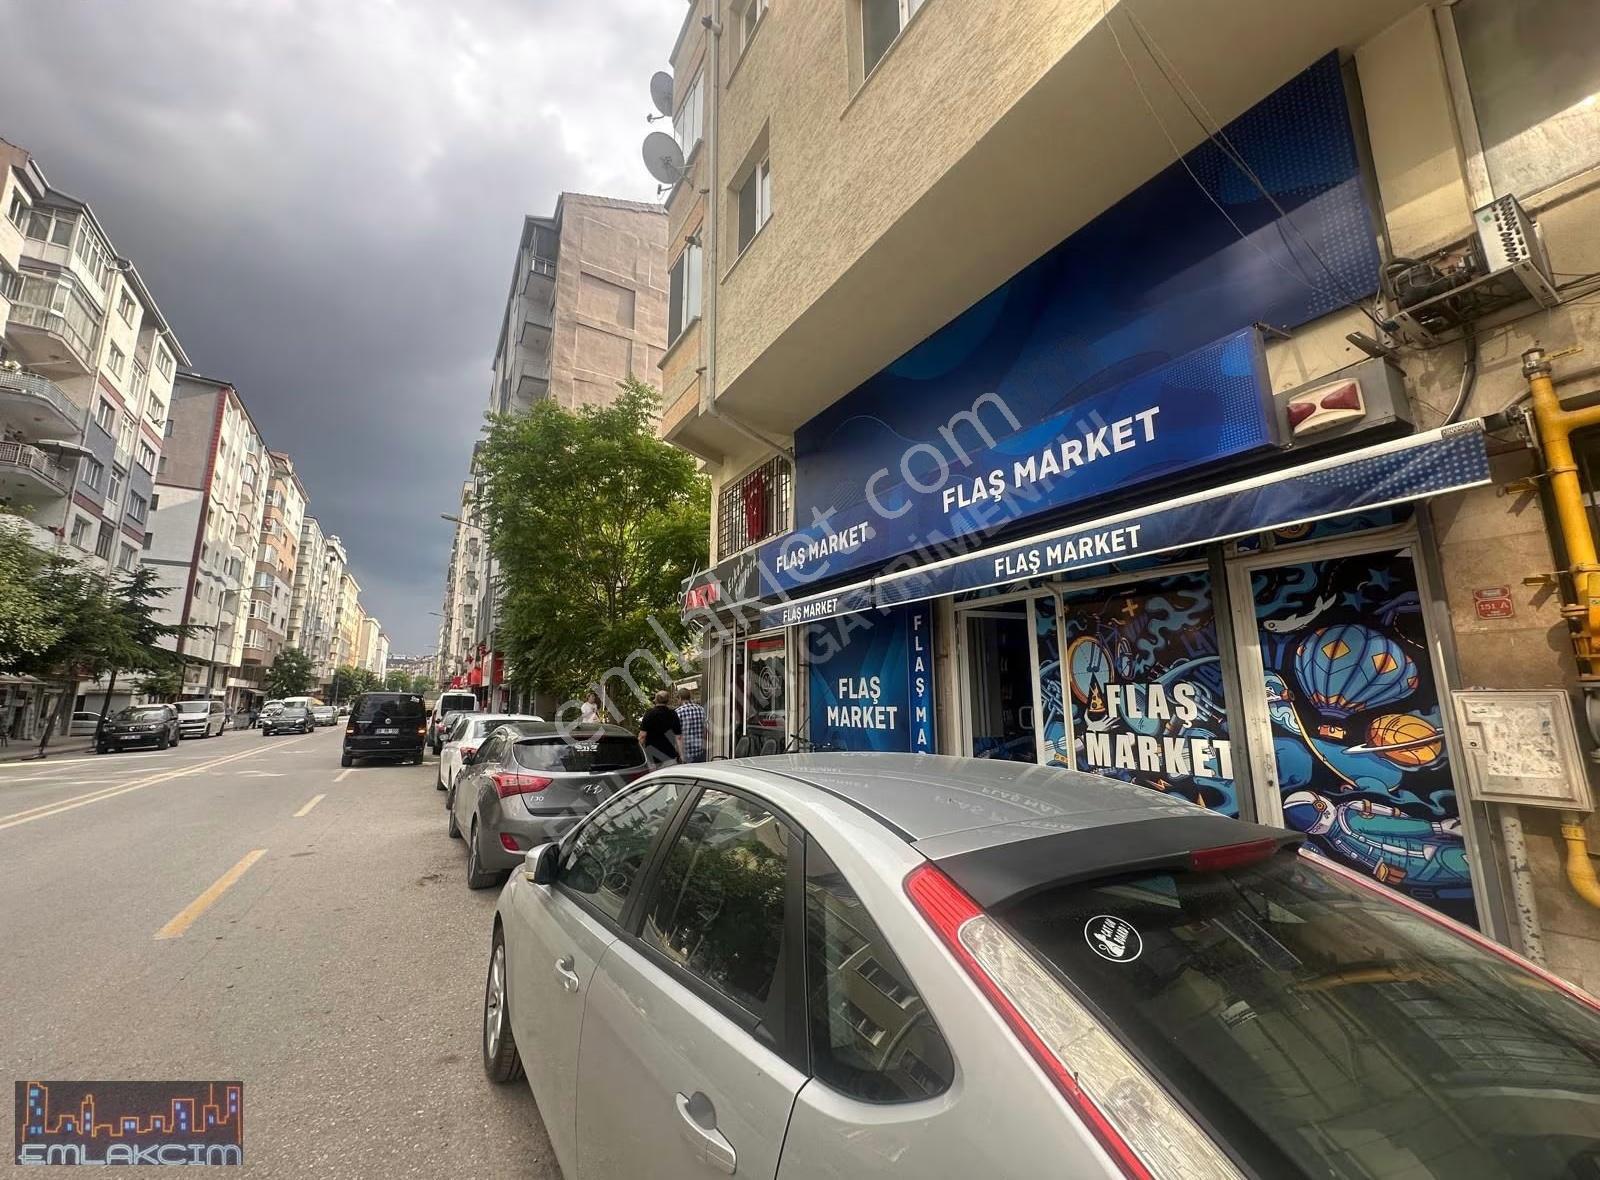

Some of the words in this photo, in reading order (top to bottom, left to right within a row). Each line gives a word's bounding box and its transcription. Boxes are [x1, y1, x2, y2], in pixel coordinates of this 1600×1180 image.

[943, 469, 1006, 514] FLAŞ
[1014, 406, 1160, 488] MARKET
[776, 547, 806, 574] FLAŞ
[809, 521, 868, 562] MARKET
[994, 549, 1041, 577] FLAŞ
[1046, 524, 1141, 566] MARKET
[783, 606, 802, 623] FLAŞ
[803, 598, 838, 618] MARKET
[839, 676, 881, 704] FLAŞ
[1106, 682, 1198, 728] FLAŞ
[827, 706, 898, 730] MARKET
[916, 707, 927, 754] MA
[1085, 731, 1234, 780] MARKET
